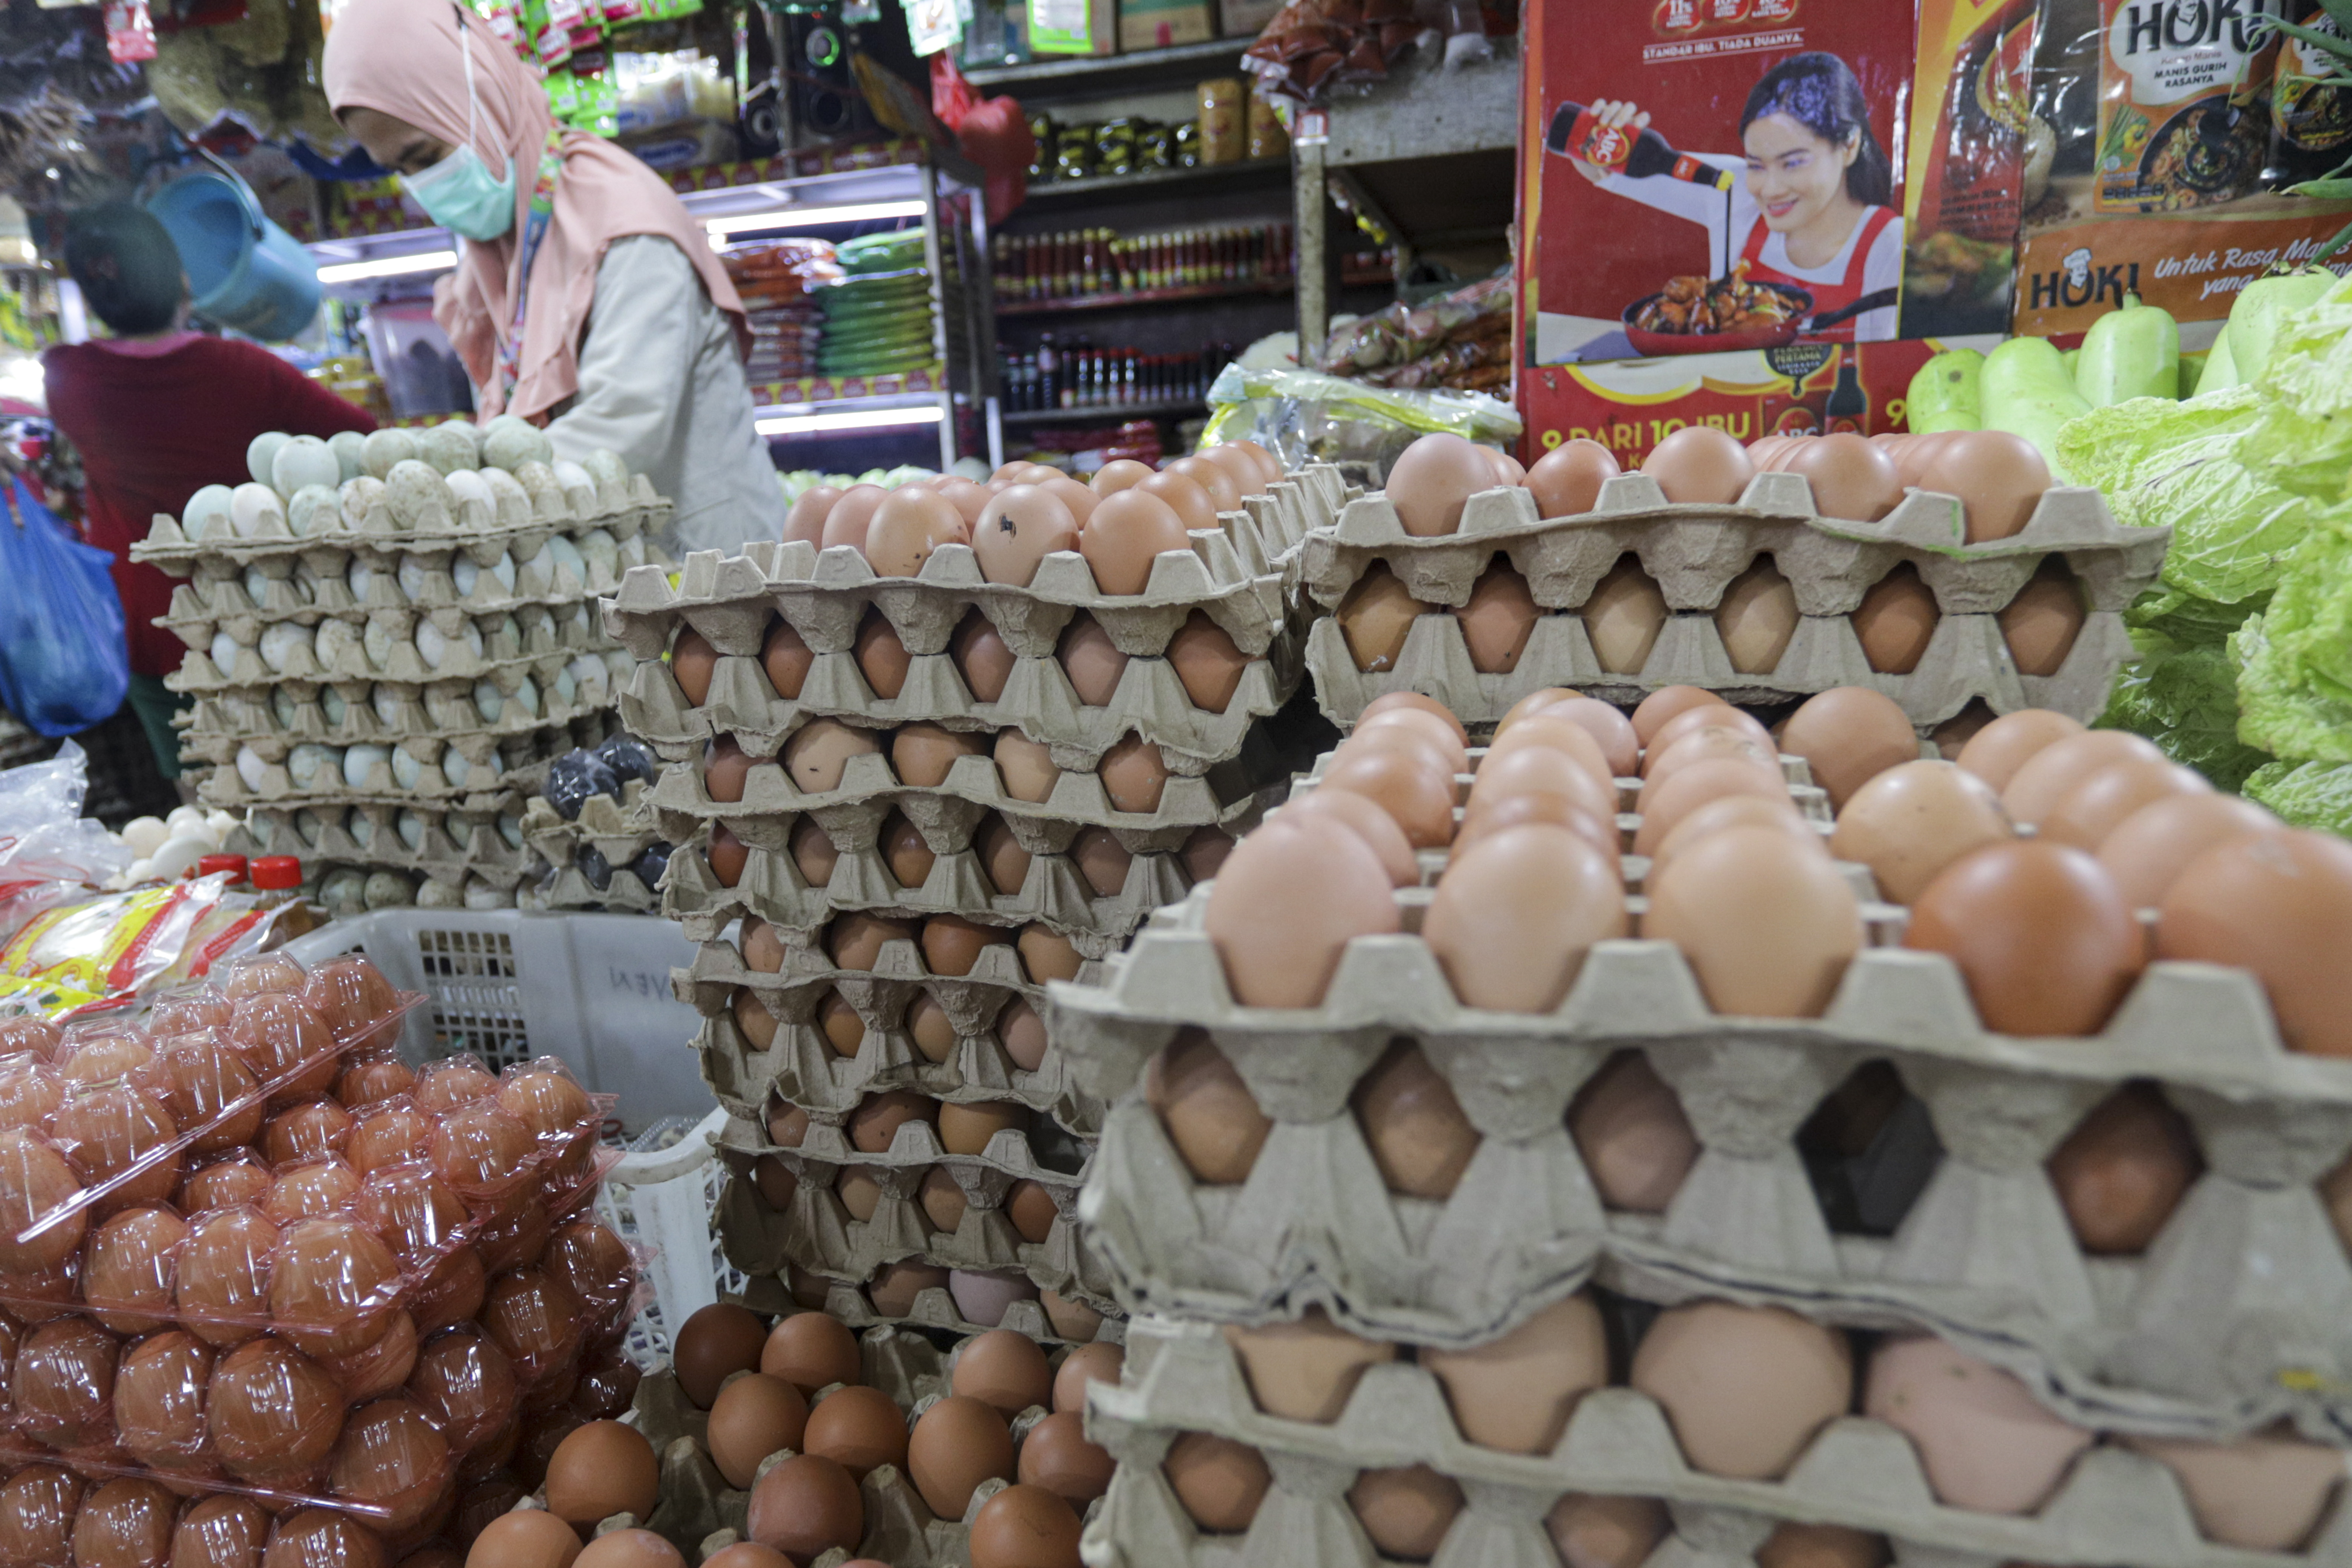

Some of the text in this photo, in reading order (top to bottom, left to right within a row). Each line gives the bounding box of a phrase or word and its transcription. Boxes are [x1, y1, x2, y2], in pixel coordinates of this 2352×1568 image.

[1643, 44, 1692, 59] STANDAR
[1718, 38, 1752, 51] TIADA
[2154, 61, 2227, 79] MANIS GURIH
[2165, 74, 2214, 88] RASANYA
[1596, 127, 1621, 162] ABC
[2154, 254, 2216, 279] Untuk
[2221, 247, 2279, 270] Rasa
[2199, 273, 2254, 301] yang
